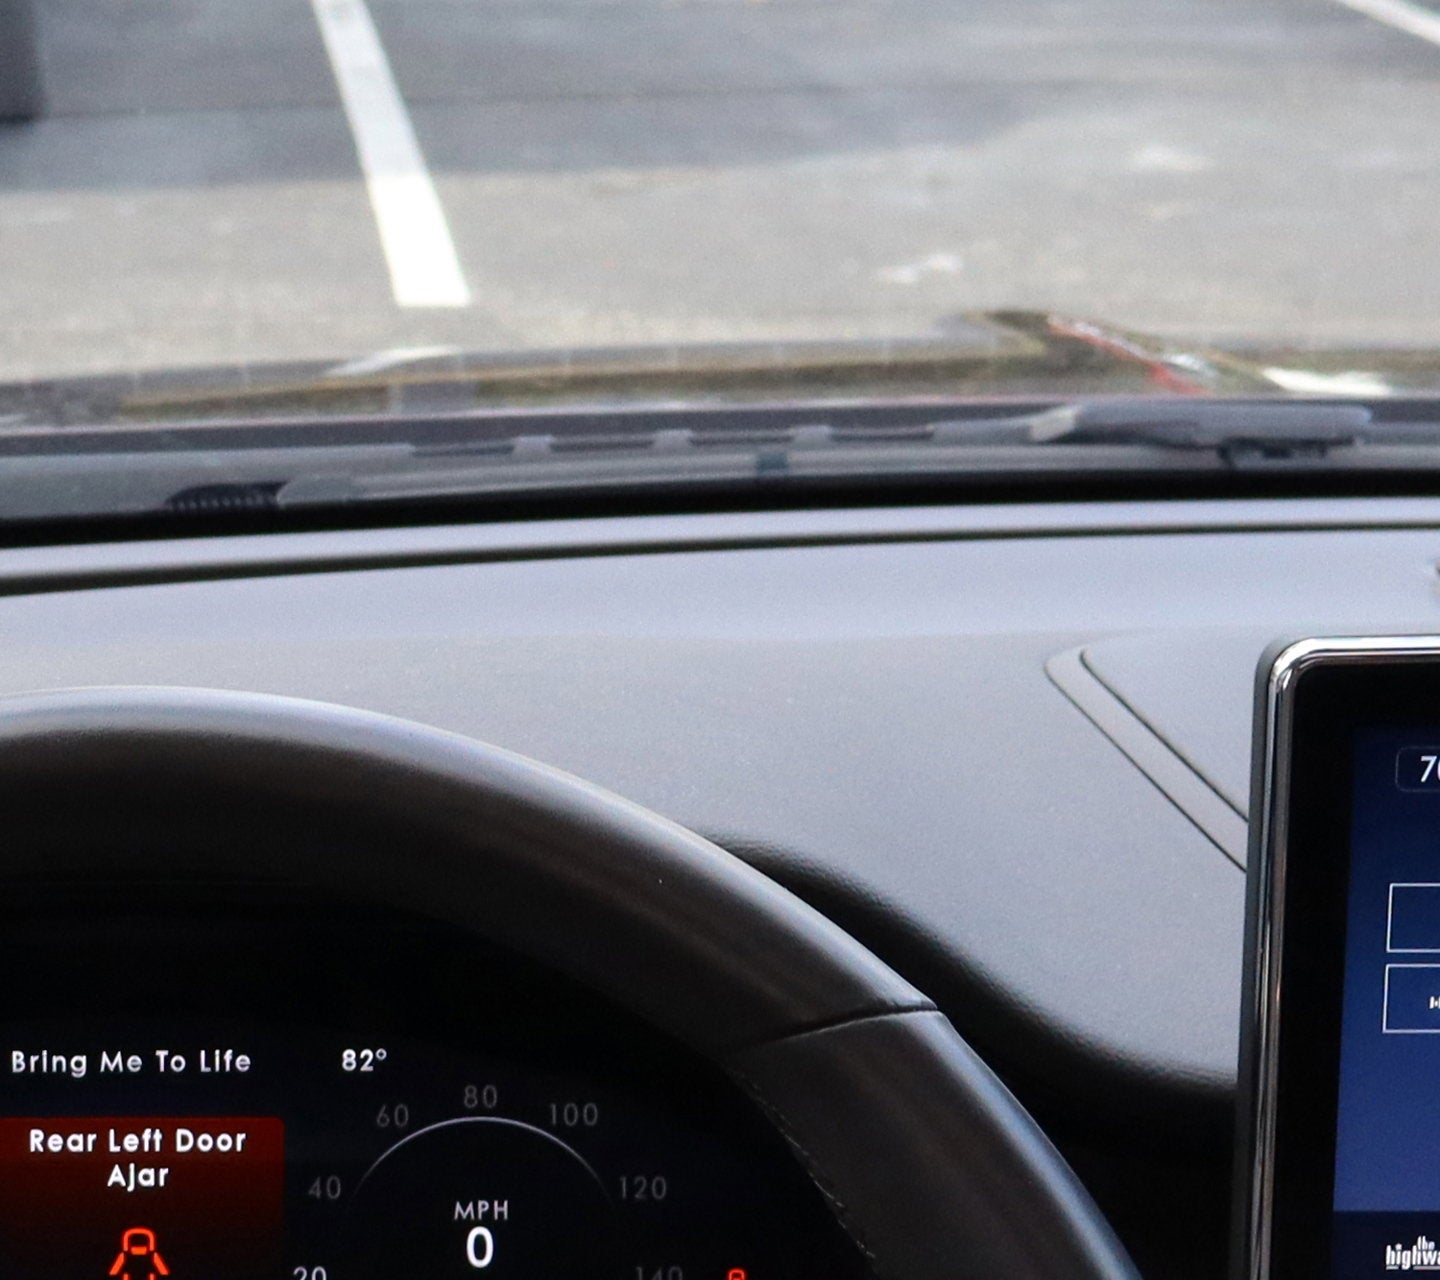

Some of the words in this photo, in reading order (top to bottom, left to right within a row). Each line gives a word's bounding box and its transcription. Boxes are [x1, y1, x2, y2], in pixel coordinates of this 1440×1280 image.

[11, 1050, 88, 1078] Bring
[100, 1050, 143, 1073] Me
[156, 1050, 187, 1073] To
[199, 1050, 252, 1073] Life
[340, 1048, 388, 1073] 82°
[463, 1085, 499, 1108] 80
[375, 1104, 410, 1128] 60
[548, 1102, 599, 1127] 100
[28, 1128, 98, 1153] Rear
[108, 1128, 164, 1153] Left
[175, 1128, 247, 1153] Door
[106, 1162, 170, 1193] Ajar
[307, 1175, 342, 1200] 40
[619, 1175, 669, 1200] 120
[453, 1200, 509, 1221] MPH
[466, 1226, 496, 1268] 0
[1416, 1235, 1435, 1250] the
